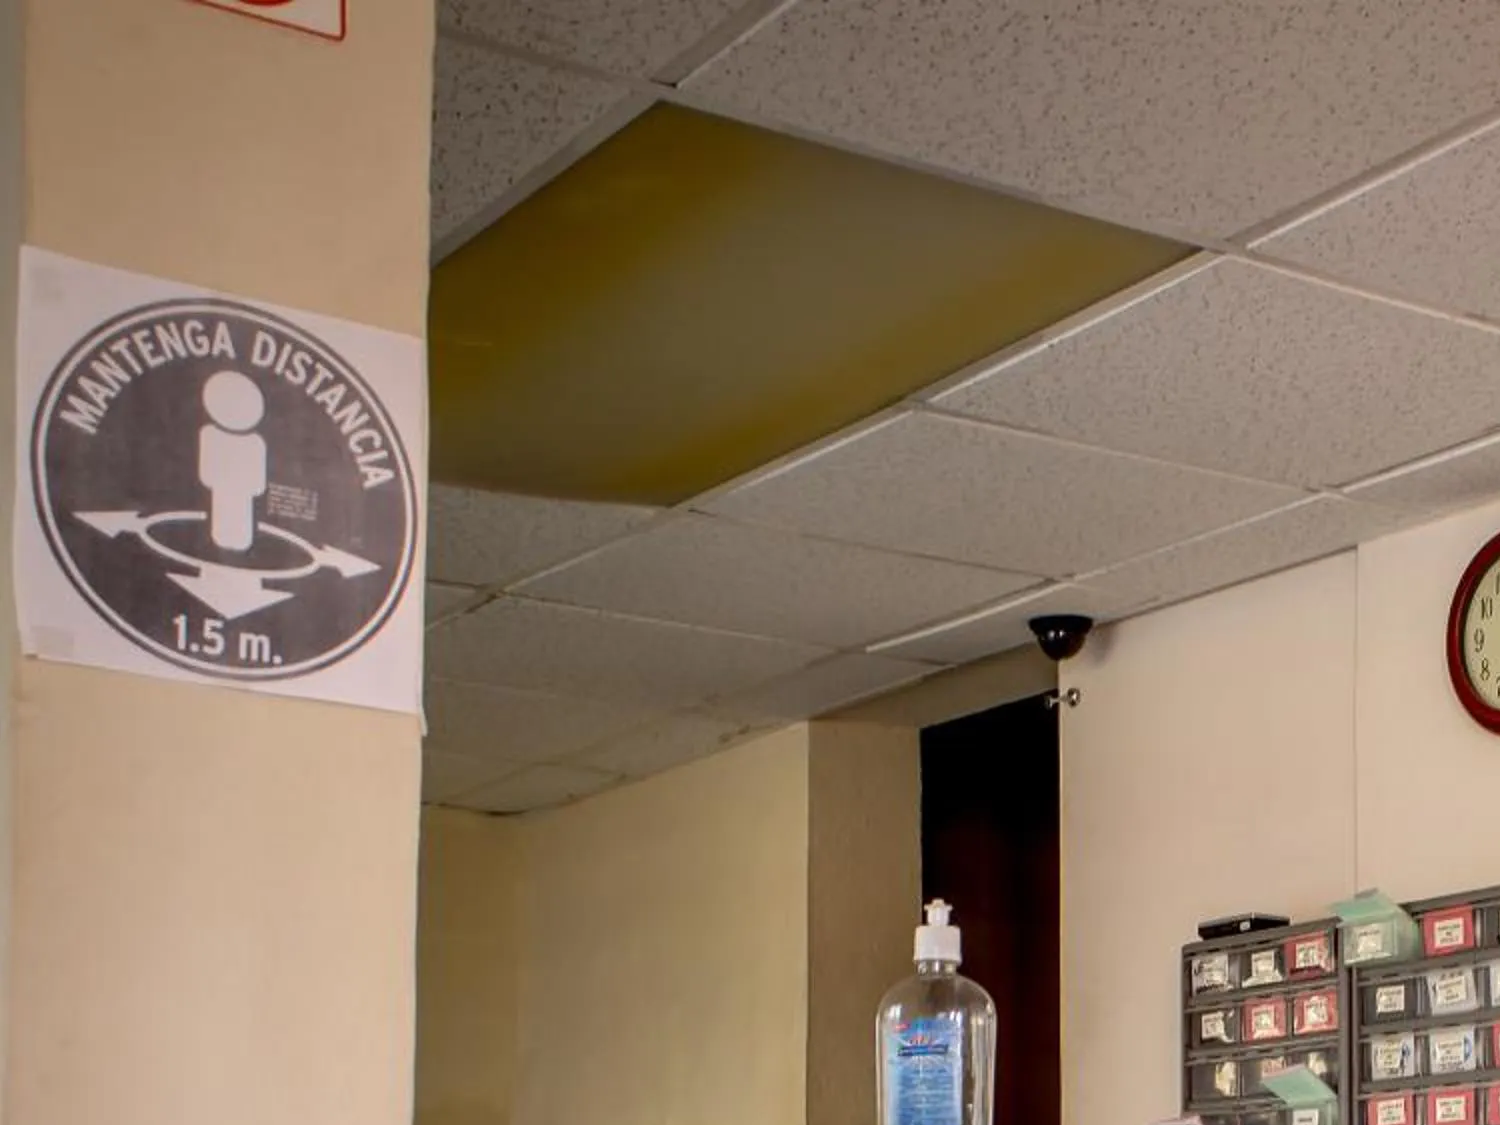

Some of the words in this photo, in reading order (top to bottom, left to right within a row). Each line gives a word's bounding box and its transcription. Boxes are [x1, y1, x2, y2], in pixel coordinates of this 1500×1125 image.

[60, 320, 236, 435] MANTENGA
[251, 330, 395, 490] DISTANCIA
[1481, 597, 1493, 620] 10
[173, 613, 225, 655] 1.5
[239, 631, 283, 665] m.
[1473, 628, 1485, 652] 9
[1479, 657, 1491, 681] 8
